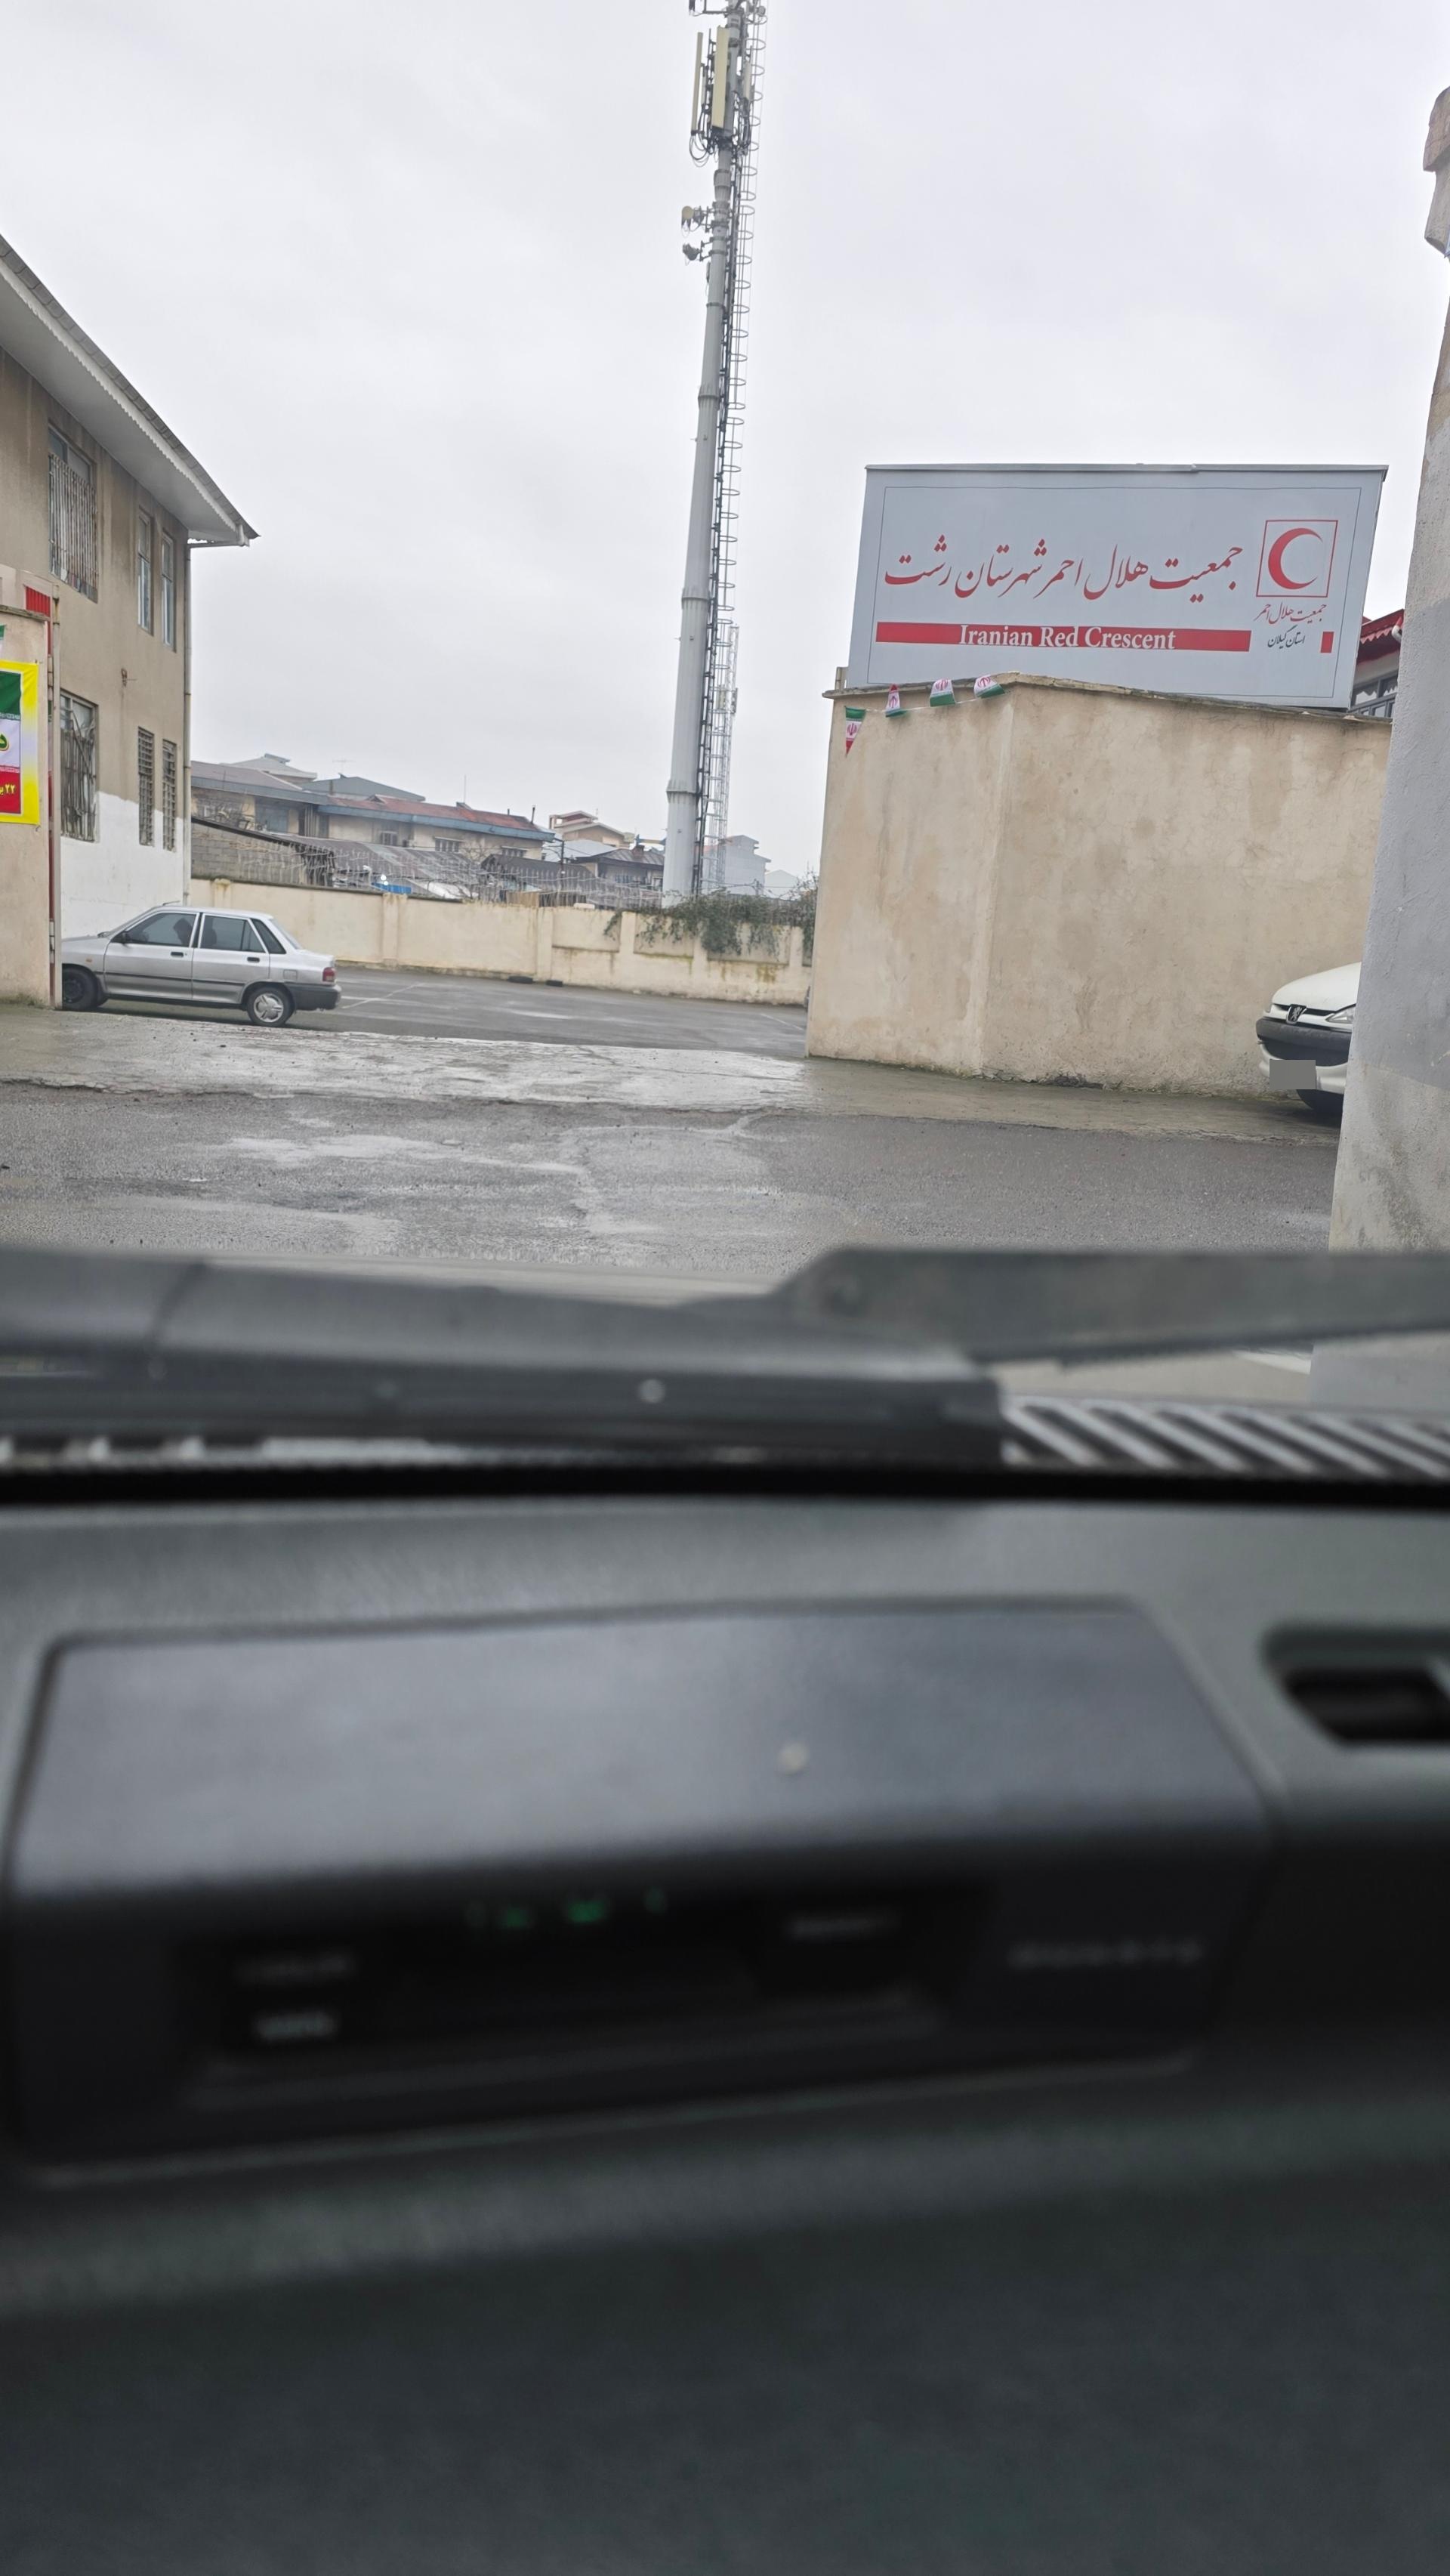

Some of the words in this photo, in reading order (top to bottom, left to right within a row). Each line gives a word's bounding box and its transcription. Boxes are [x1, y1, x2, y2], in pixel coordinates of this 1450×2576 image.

[885, 534, 952, 585] رشت
[955, 539, 1047, 599] شهرستان
[1084, 544, 1149, 601] هلال
[1149, 546, 1243, 603] جمعیت
[1033, 558, 1082, 598] احمر
[1254, 604, 1271, 621] احمر
[1269, 601, 1294, 625] هلال
[1290, 604, 1327, 624] جمعیت
[959, 625, 1033, 647] Iranian
[1038, 626, 1079, 648] Red
[1084, 626, 1177, 650] Crescent
[1285, 632, 1306, 648] استان
